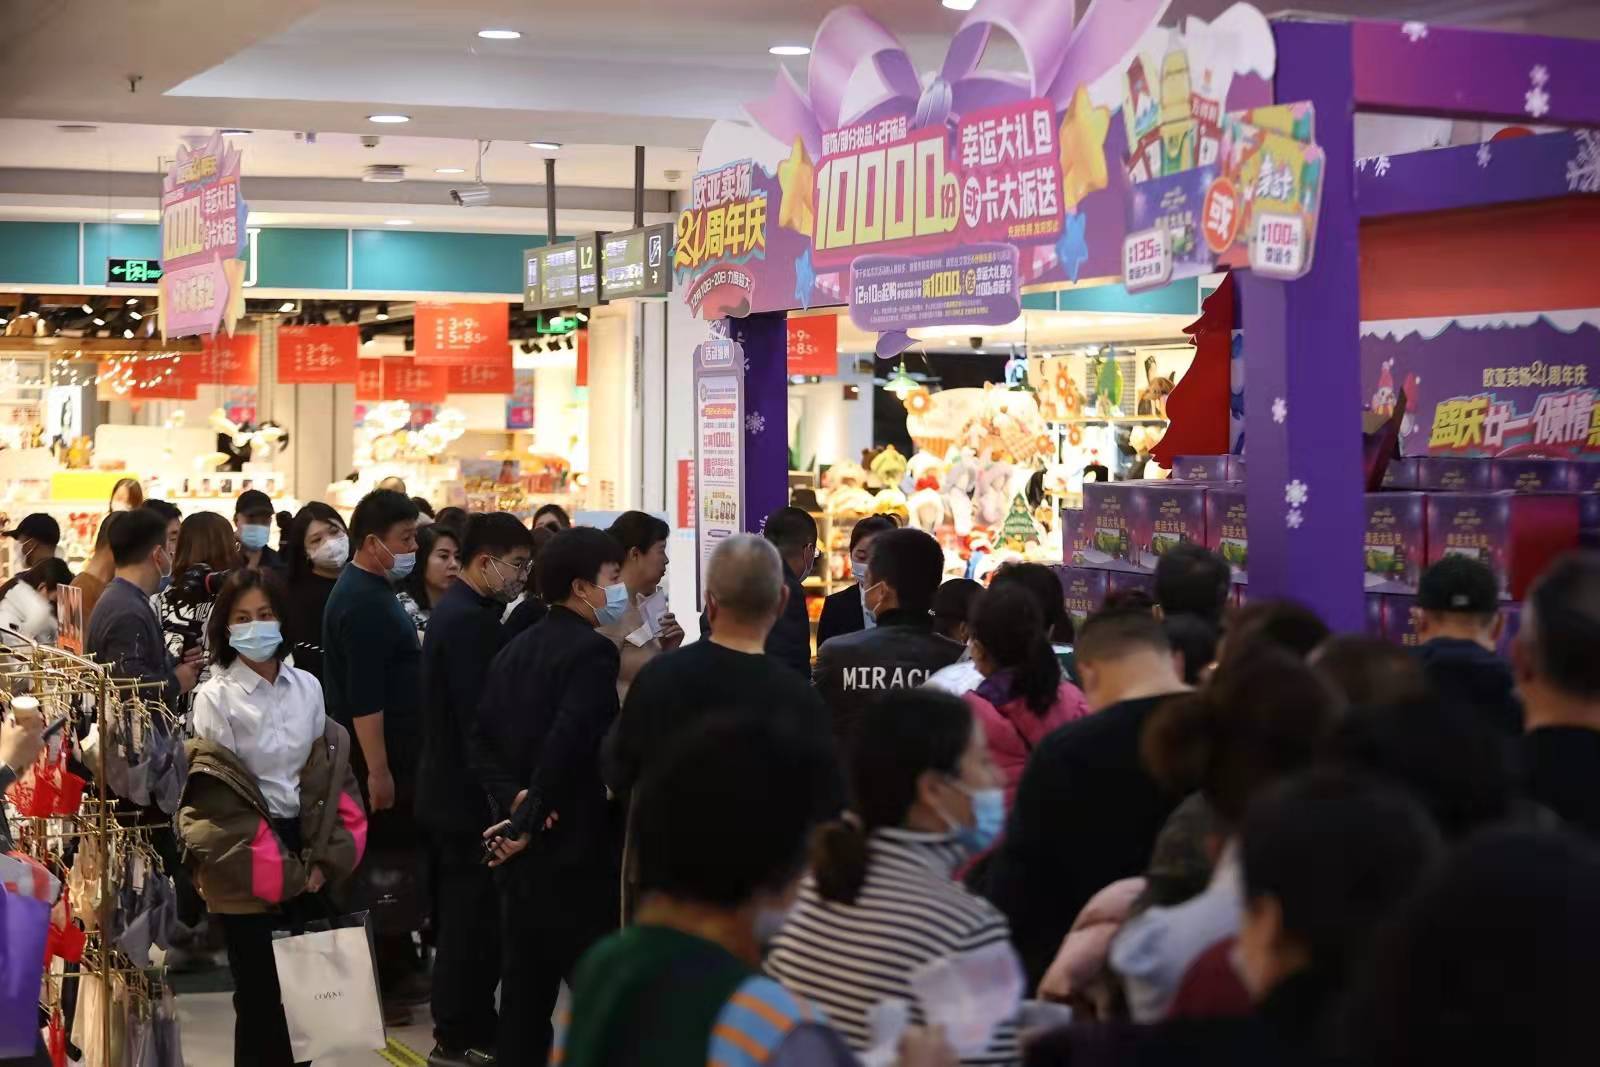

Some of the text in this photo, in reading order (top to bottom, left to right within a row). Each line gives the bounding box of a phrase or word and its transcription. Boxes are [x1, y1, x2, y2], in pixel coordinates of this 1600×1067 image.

[962, 109, 1053, 169] 幸运大礼包
[694, 163, 751, 208] 欧亚卖场
[580, 246, 593, 269] L2
[674, 196, 767, 268] 21周年庆
